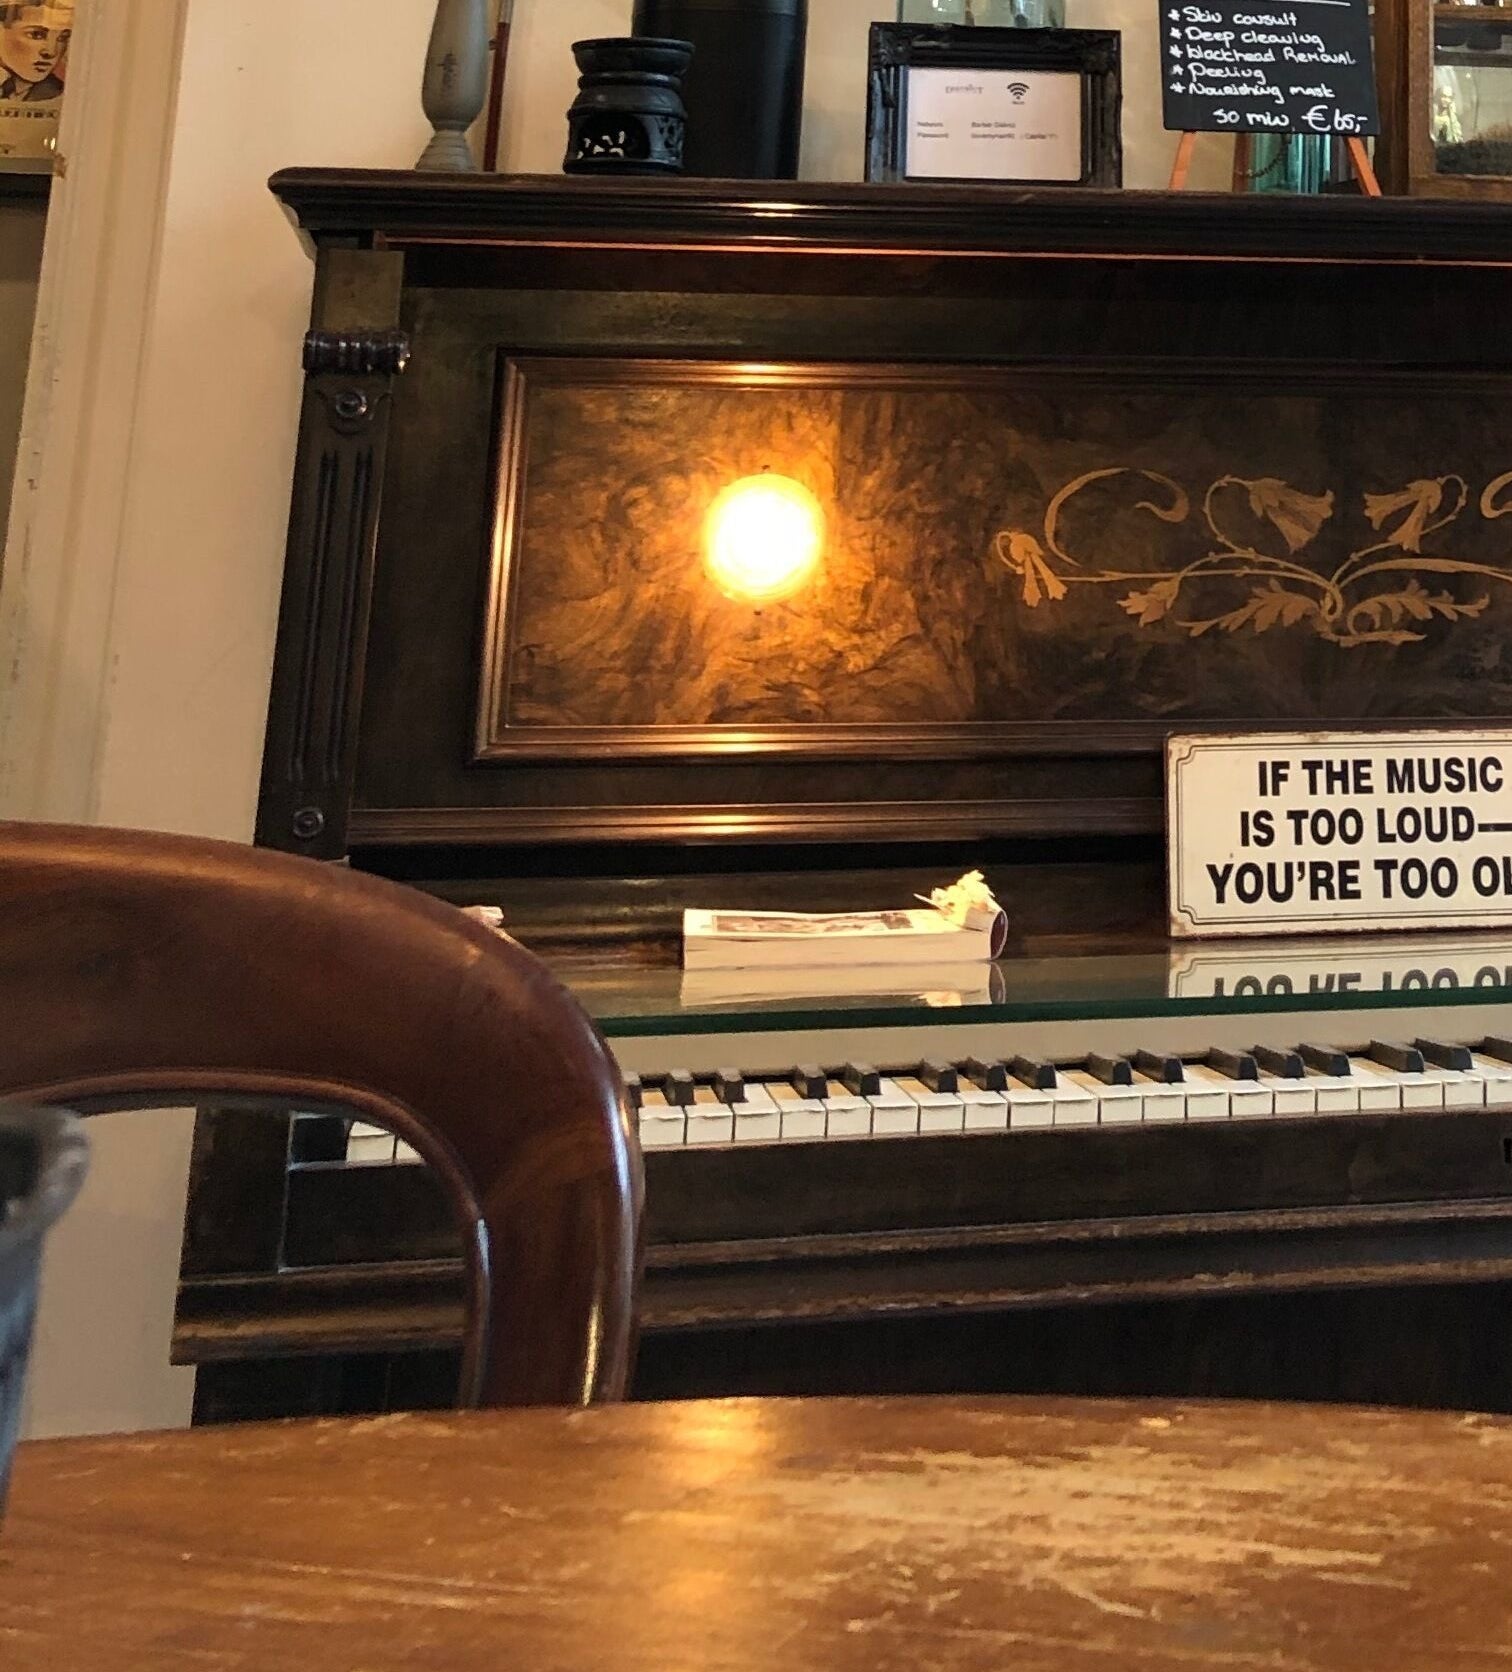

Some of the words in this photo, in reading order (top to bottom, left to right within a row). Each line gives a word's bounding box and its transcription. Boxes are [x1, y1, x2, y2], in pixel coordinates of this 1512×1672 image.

[1232, 12, 1298, 26] consult
[1185, 26, 1235, 48] Deep
[1241, 30, 1325, 52] cleaning
[1187, 62, 1267, 85] Peeling
[1188, 82, 1285, 105] Nourishing
[1289, 83, 1336, 99] mask
[1258, 760, 1290, 797] IF
[1301, 759, 1374, 796] THE
[1386, 756, 1504, 794] MUSIC
[1239, 810, 1275, 847] IS
[1286, 807, 1364, 847] TOO
[1205, 859, 1362, 904] YOU'RE
[1373, 856, 1459, 900] TOO
